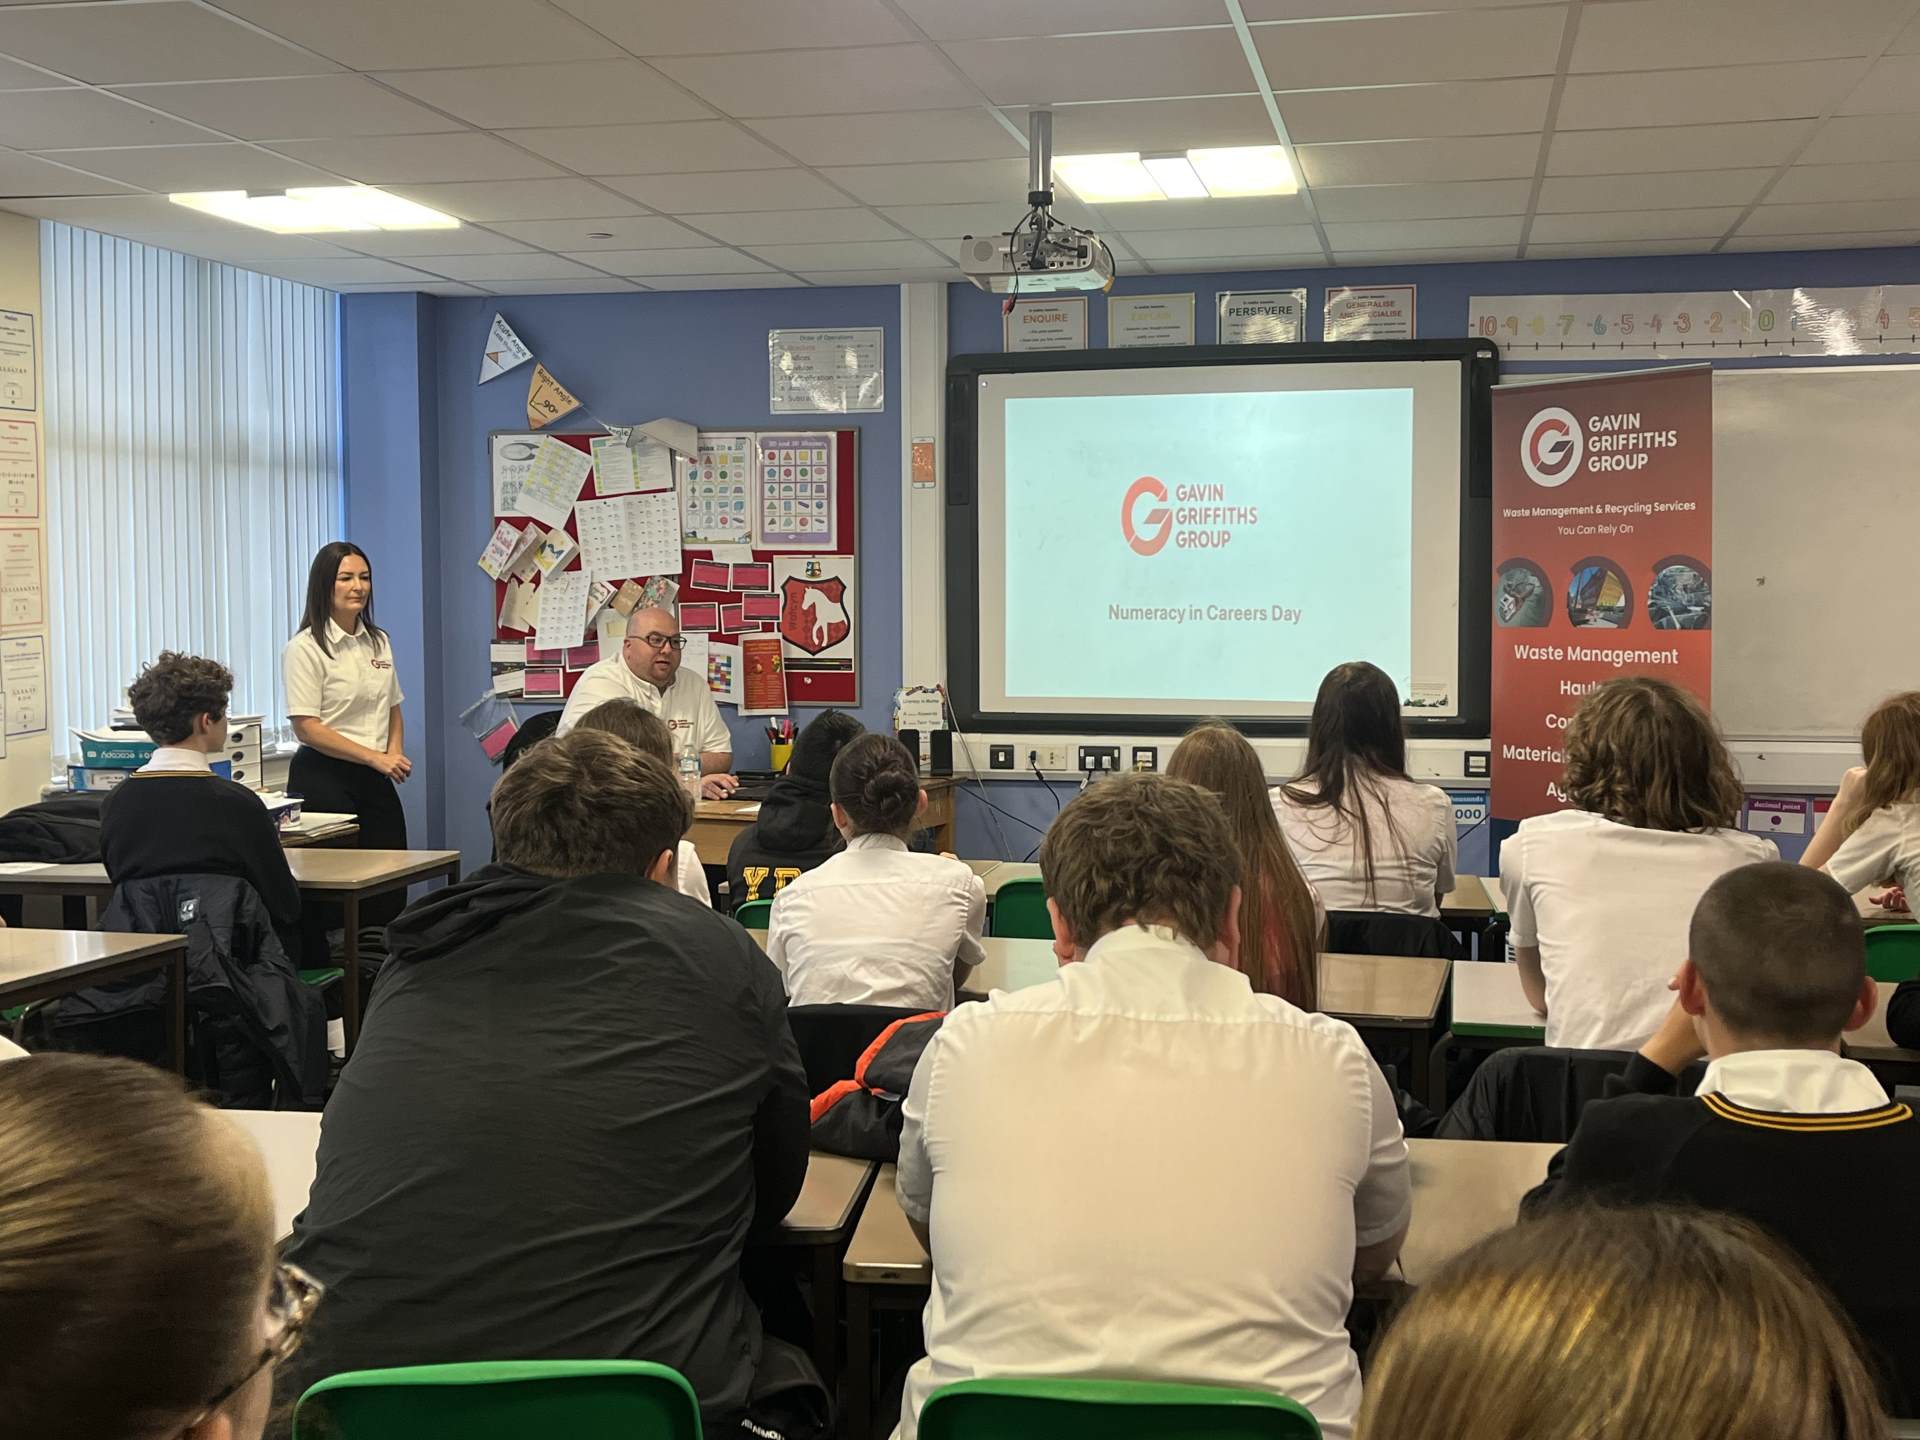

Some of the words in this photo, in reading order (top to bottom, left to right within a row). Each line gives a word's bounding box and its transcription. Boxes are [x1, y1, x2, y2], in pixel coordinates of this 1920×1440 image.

[1023, 313, 1069, 324] ENQUIRE
[1228, 305, 1294, 317] PERSEVERE
[1758, 308, 1775, 331] 0
[1588, 413, 1641, 432] GAVIN
[1588, 430, 1678, 453] GRIFFITHS
[1588, 453, 1649, 472] GROUP
[1176, 484, 1224, 502] GAVIN
[1175, 507, 1258, 525] GRIFFITHS
[1503, 507, 1531, 518] Waste
[1531, 505, 1594, 519] Management
[1595, 504, 1603, 514] &
[1604, 502, 1652, 516] Recycling
[1653, 500, 1697, 513] Services
[1175, 530, 1231, 548] GROUP
[1557, 525, 1575, 536] You
[1576, 524, 1596, 535] Can
[1598, 523, 1617, 537] Rely
[1619, 522, 1634, 534] On
[1108, 604, 1186, 625] Numeracy
[1189, 604, 1202, 620] in
[1206, 604, 1268, 622] Careers
[1271, 604, 1302, 625] Day
[1514, 644, 1564, 661] Waste
[1567, 646, 1679, 667] Management
